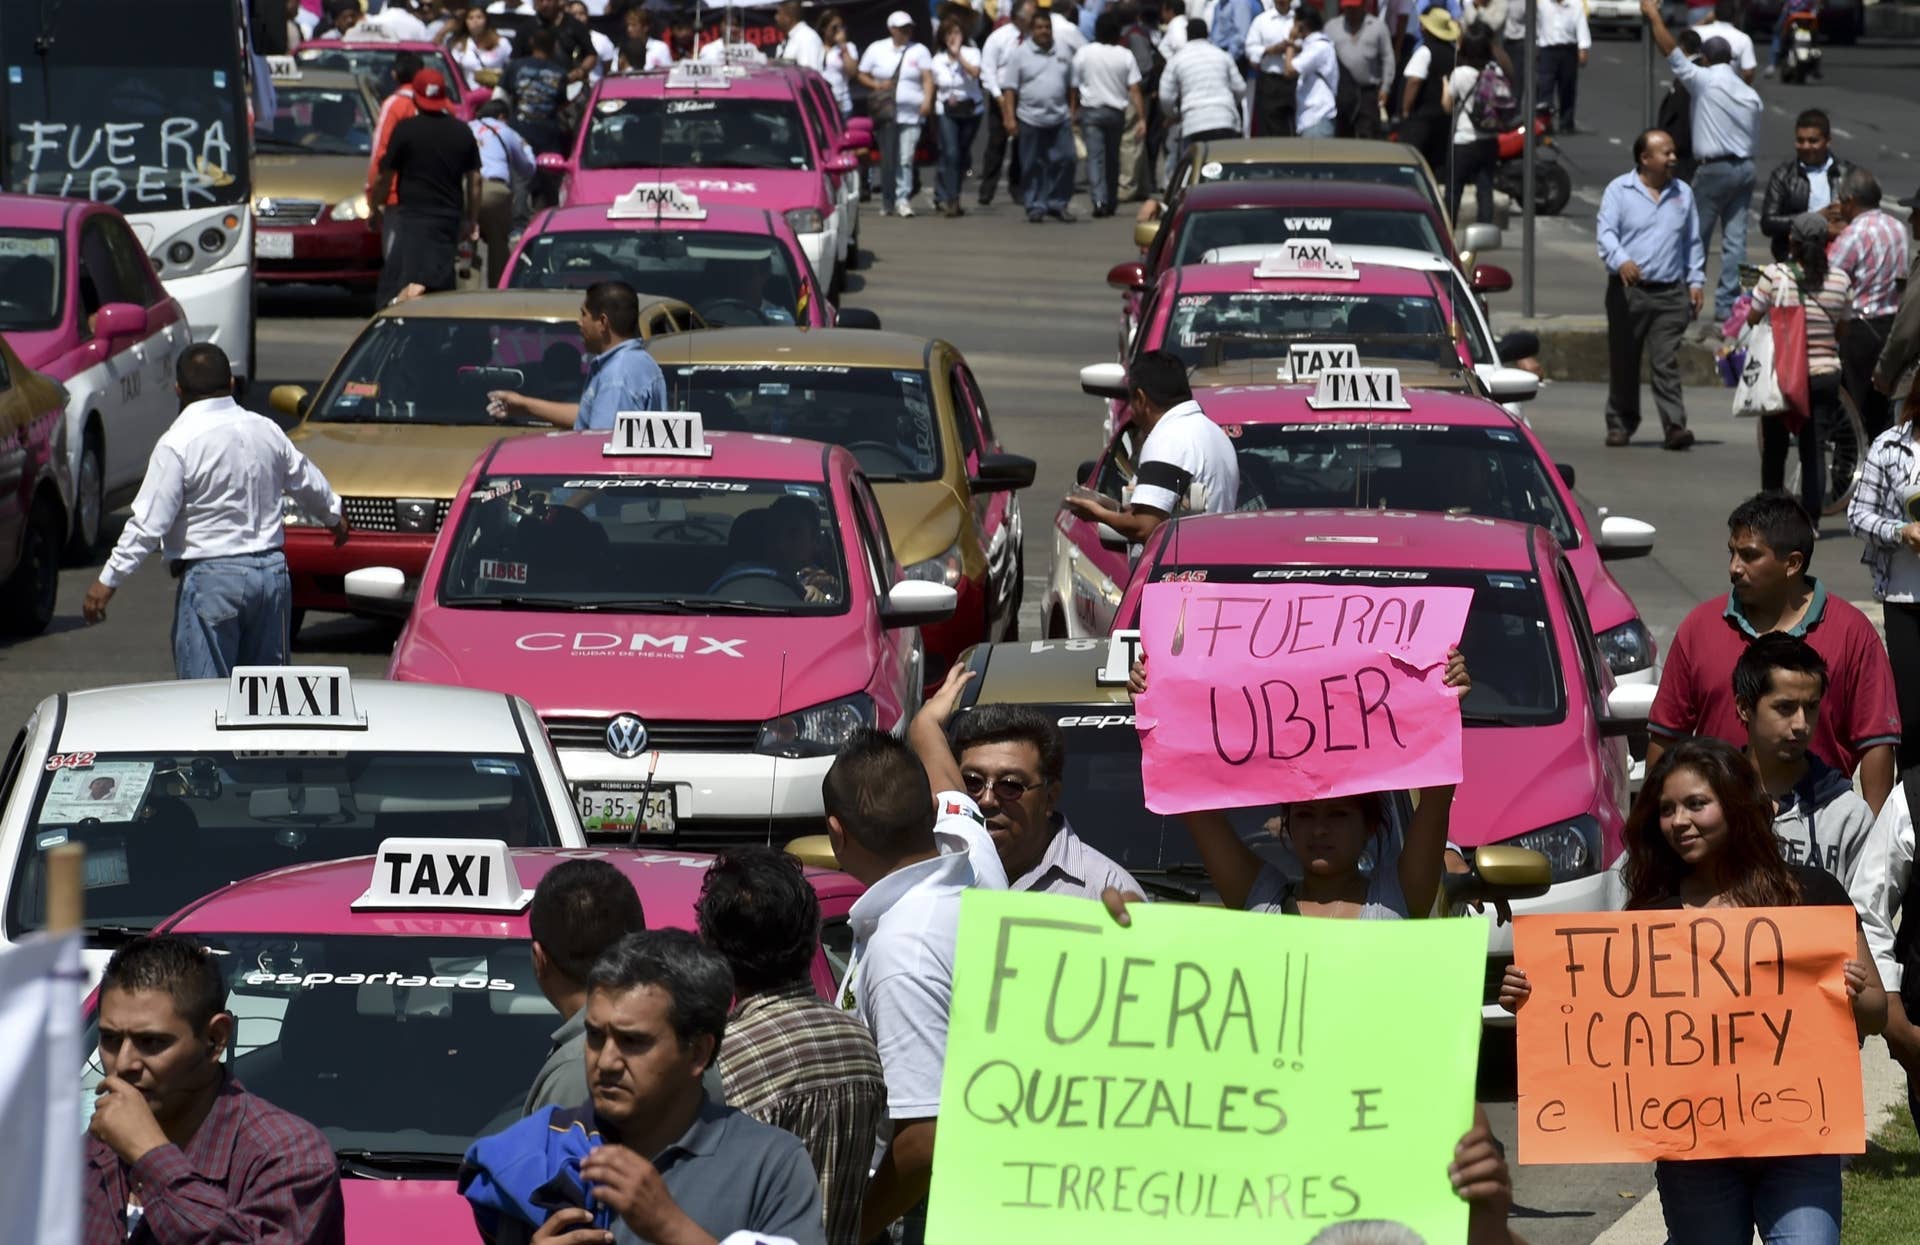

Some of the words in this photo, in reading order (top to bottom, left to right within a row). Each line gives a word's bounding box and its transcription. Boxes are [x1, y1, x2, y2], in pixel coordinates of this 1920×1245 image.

[685, 64, 712, 76] TAXI
[19, 117, 231, 173] FUERA
[637, 189, 674, 203] TAXI
[1288, 245, 1327, 260] TAXI
[1293, 350, 1353, 375] TAXI
[1326, 374, 1394, 401] TAXI
[620, 418, 693, 449] TAXI
[564, 479, 749, 492] espartacos
[483, 562, 526, 582] LIBRE
[1252, 568, 1430, 581] espartacos
[515, 632, 748, 658] CDMX
[239, 675, 343, 717] TAXI
[1210, 666, 1407, 766] UBER
[46, 751, 97, 771] 342
[583, 796, 666, 818] B-35-54
[383, 853, 491, 896] TAXI
[1555, 917, 1786, 999] FUERA
[246, 970, 516, 992] espartacos
[984, 917, 1309, 1072] FUERA!!
[1560, 1003, 1793, 1068] ¡CABIFY
[964, 1060, 1287, 1135] QUETZALES
[1348, 1087, 1389, 1132] E
[1536, 1099, 1567, 1133] e
[1001, 1161, 1361, 1219] IRREGULARES
